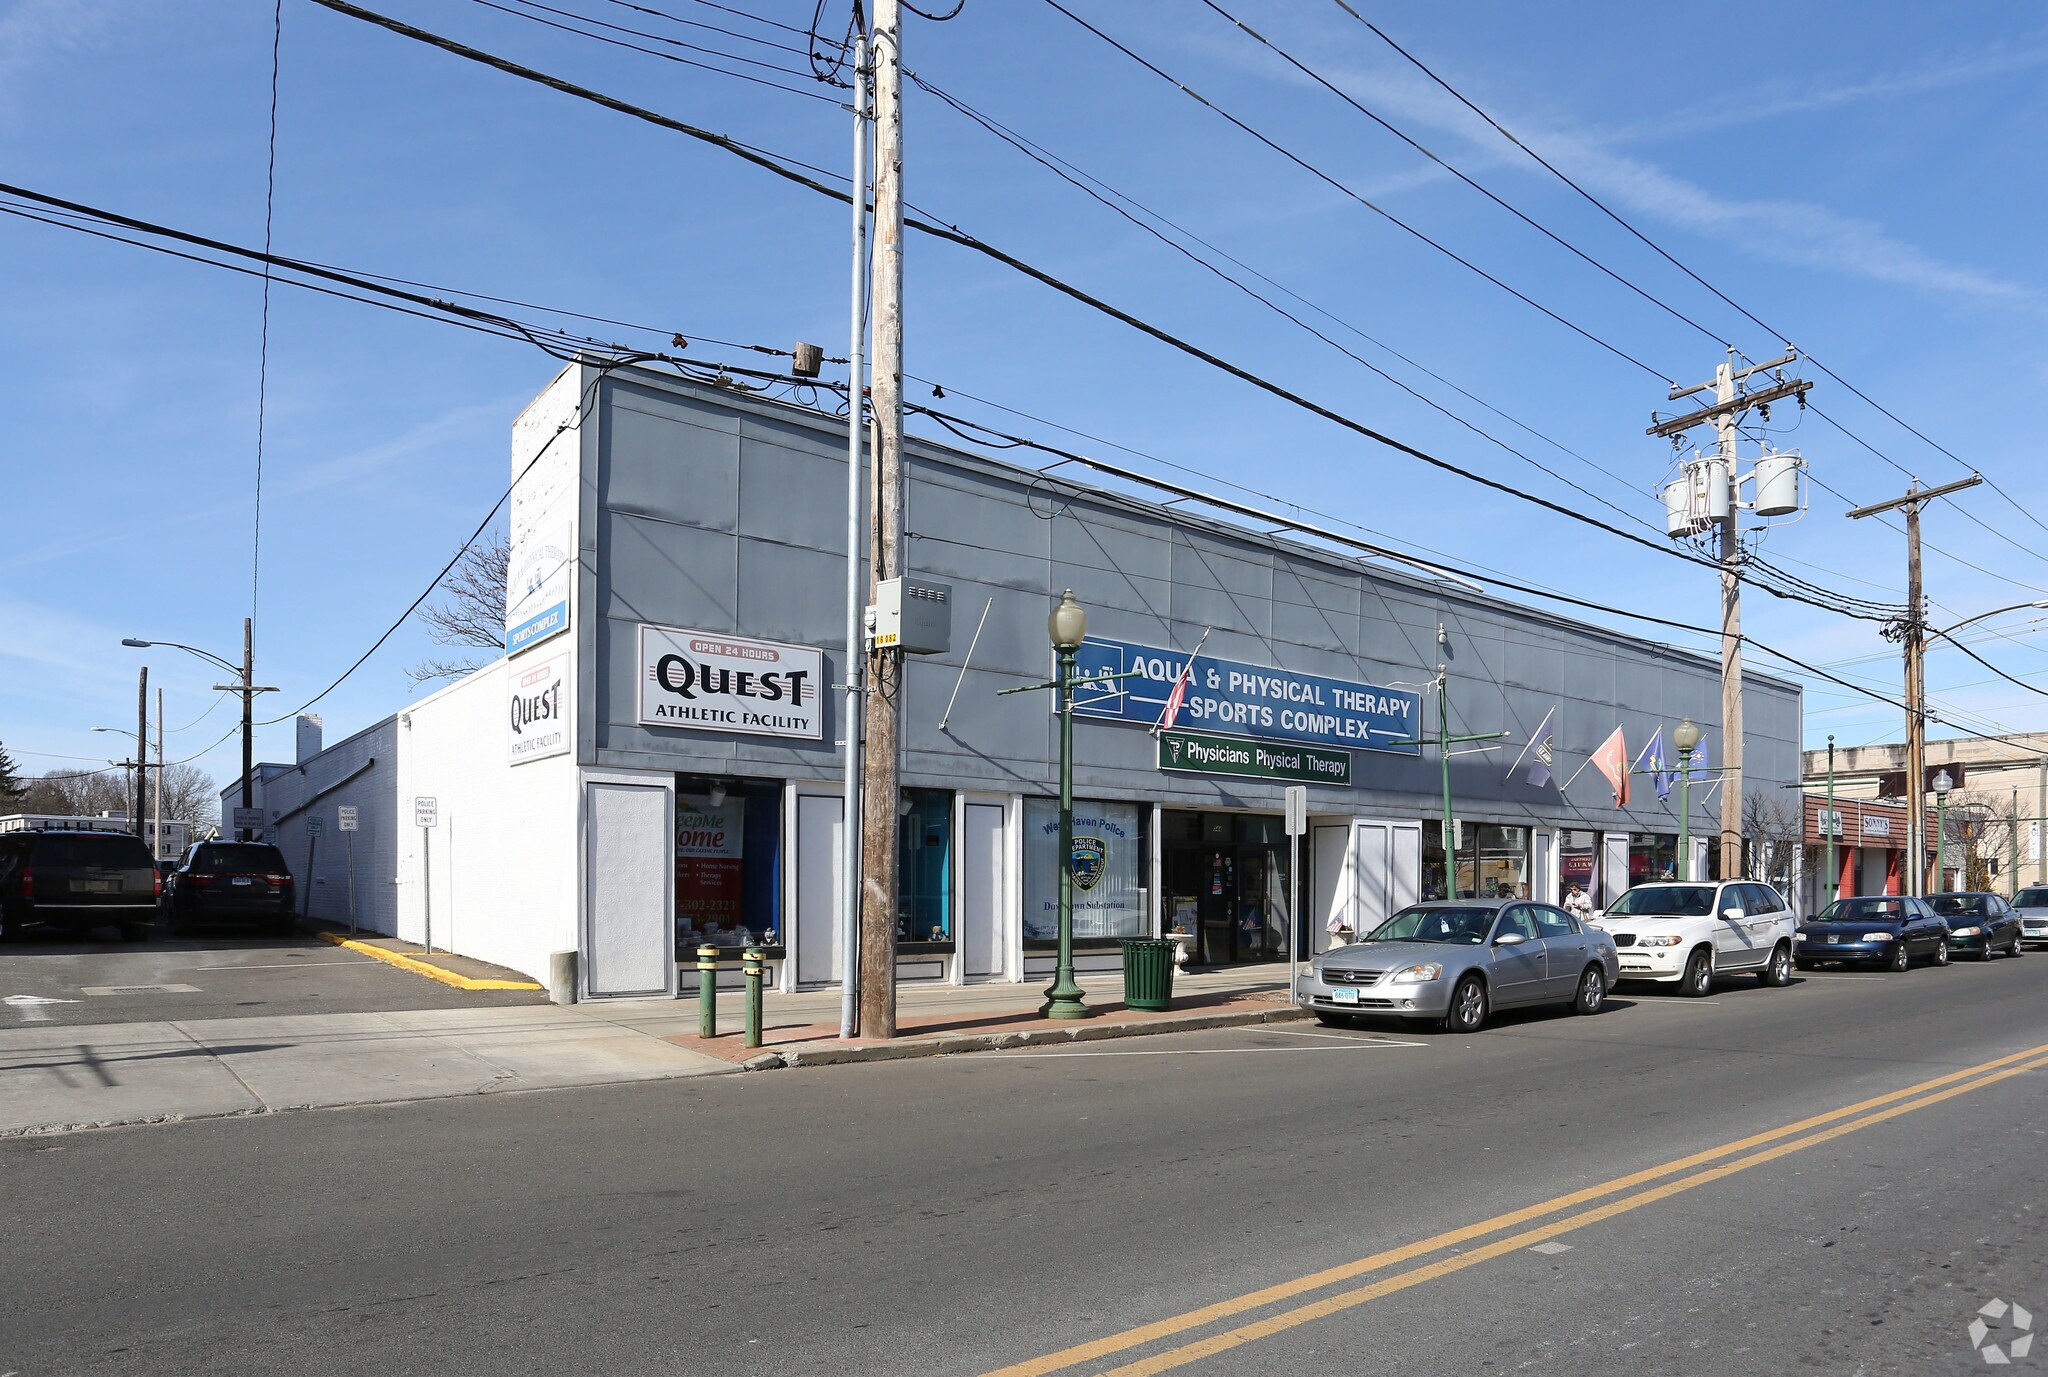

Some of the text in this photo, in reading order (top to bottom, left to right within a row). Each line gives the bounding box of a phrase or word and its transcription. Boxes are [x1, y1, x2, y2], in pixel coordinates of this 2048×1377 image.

[512, 611, 559, 646] SPORTS COMPLEX
[695, 642, 775, 660] OPEN 24 HOURS
[656, 653, 808, 707] QUEST
[1131, 655, 1411, 718] AQUA & PHYSICAL THERAPY
[511, 678, 561, 734] QUEST
[655, 704, 810, 730] ATHLETIC FACILITY
[1190, 696, 1370, 740] SPORTS COMPLEX
[512, 731, 562, 754] ATHLETIC FACILITY
[1187, 742, 1346, 776] Physicians Physical Therapy
[678, 814, 724, 829] eepMe
[1043, 822, 1061, 835] We
[1098, 818, 1126, 838] Police
[1864, 817, 1888, 830] SONNY'S
[678, 830, 724, 848] ome
[1072, 844, 1104, 854] EPARTMENT
[700, 872, 721, 880] Therapy
[680, 900, 736, 910] -302-2323
[1044, 900, 1125, 910] Dowwn Substation
